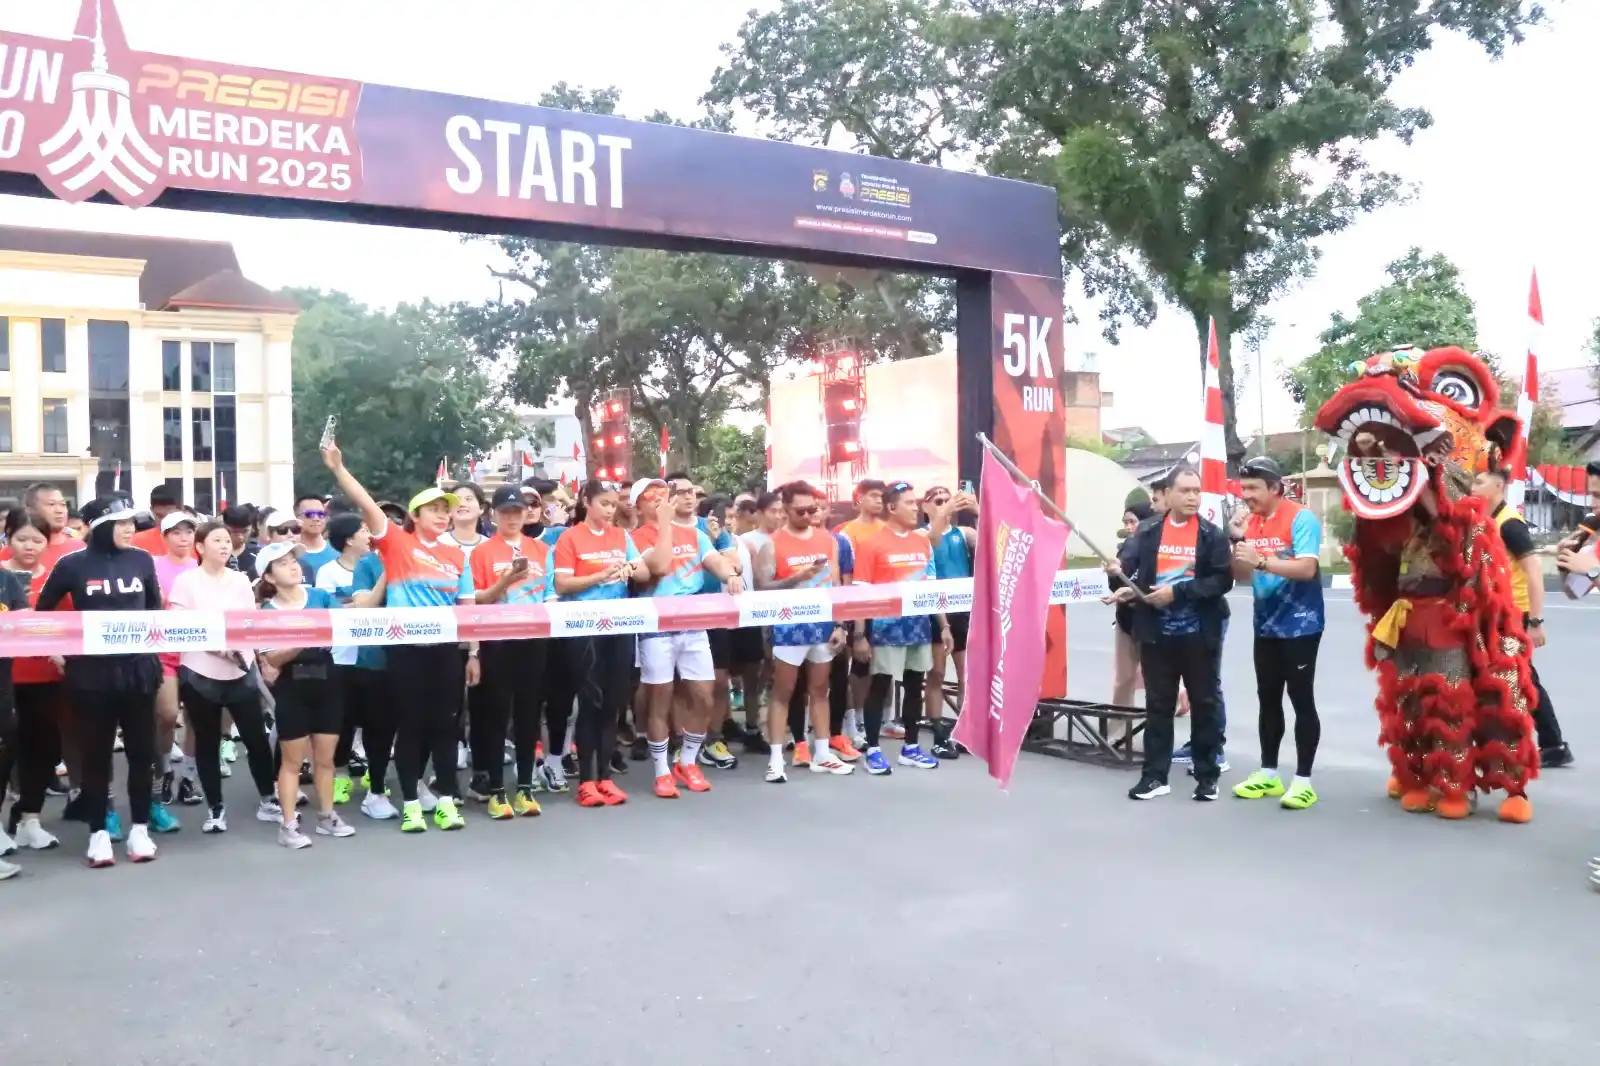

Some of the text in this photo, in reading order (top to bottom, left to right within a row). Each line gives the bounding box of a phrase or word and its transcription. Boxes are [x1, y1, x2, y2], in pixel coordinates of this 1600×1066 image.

[137, 63, 350, 118] PRESISI
[150, 105, 350, 156] MERDEKA
[167, 147, 352, 191] RUN 2025
[445, 114, 632, 209] START
[860, 187, 911, 204] PRESISI
[1003, 312, 1054, 379] 5K
[1023, 385, 1054, 413] RUN
[1013, 531, 1034, 574] 2025
[86, 577, 143, 596] FILA
[164, 627, 207, 635] MERDEKA
[349, 628, 384, 638] ROAD TO
[565, 619, 594, 629] ROAD TO
[102, 634, 141, 645] ROAD TO
